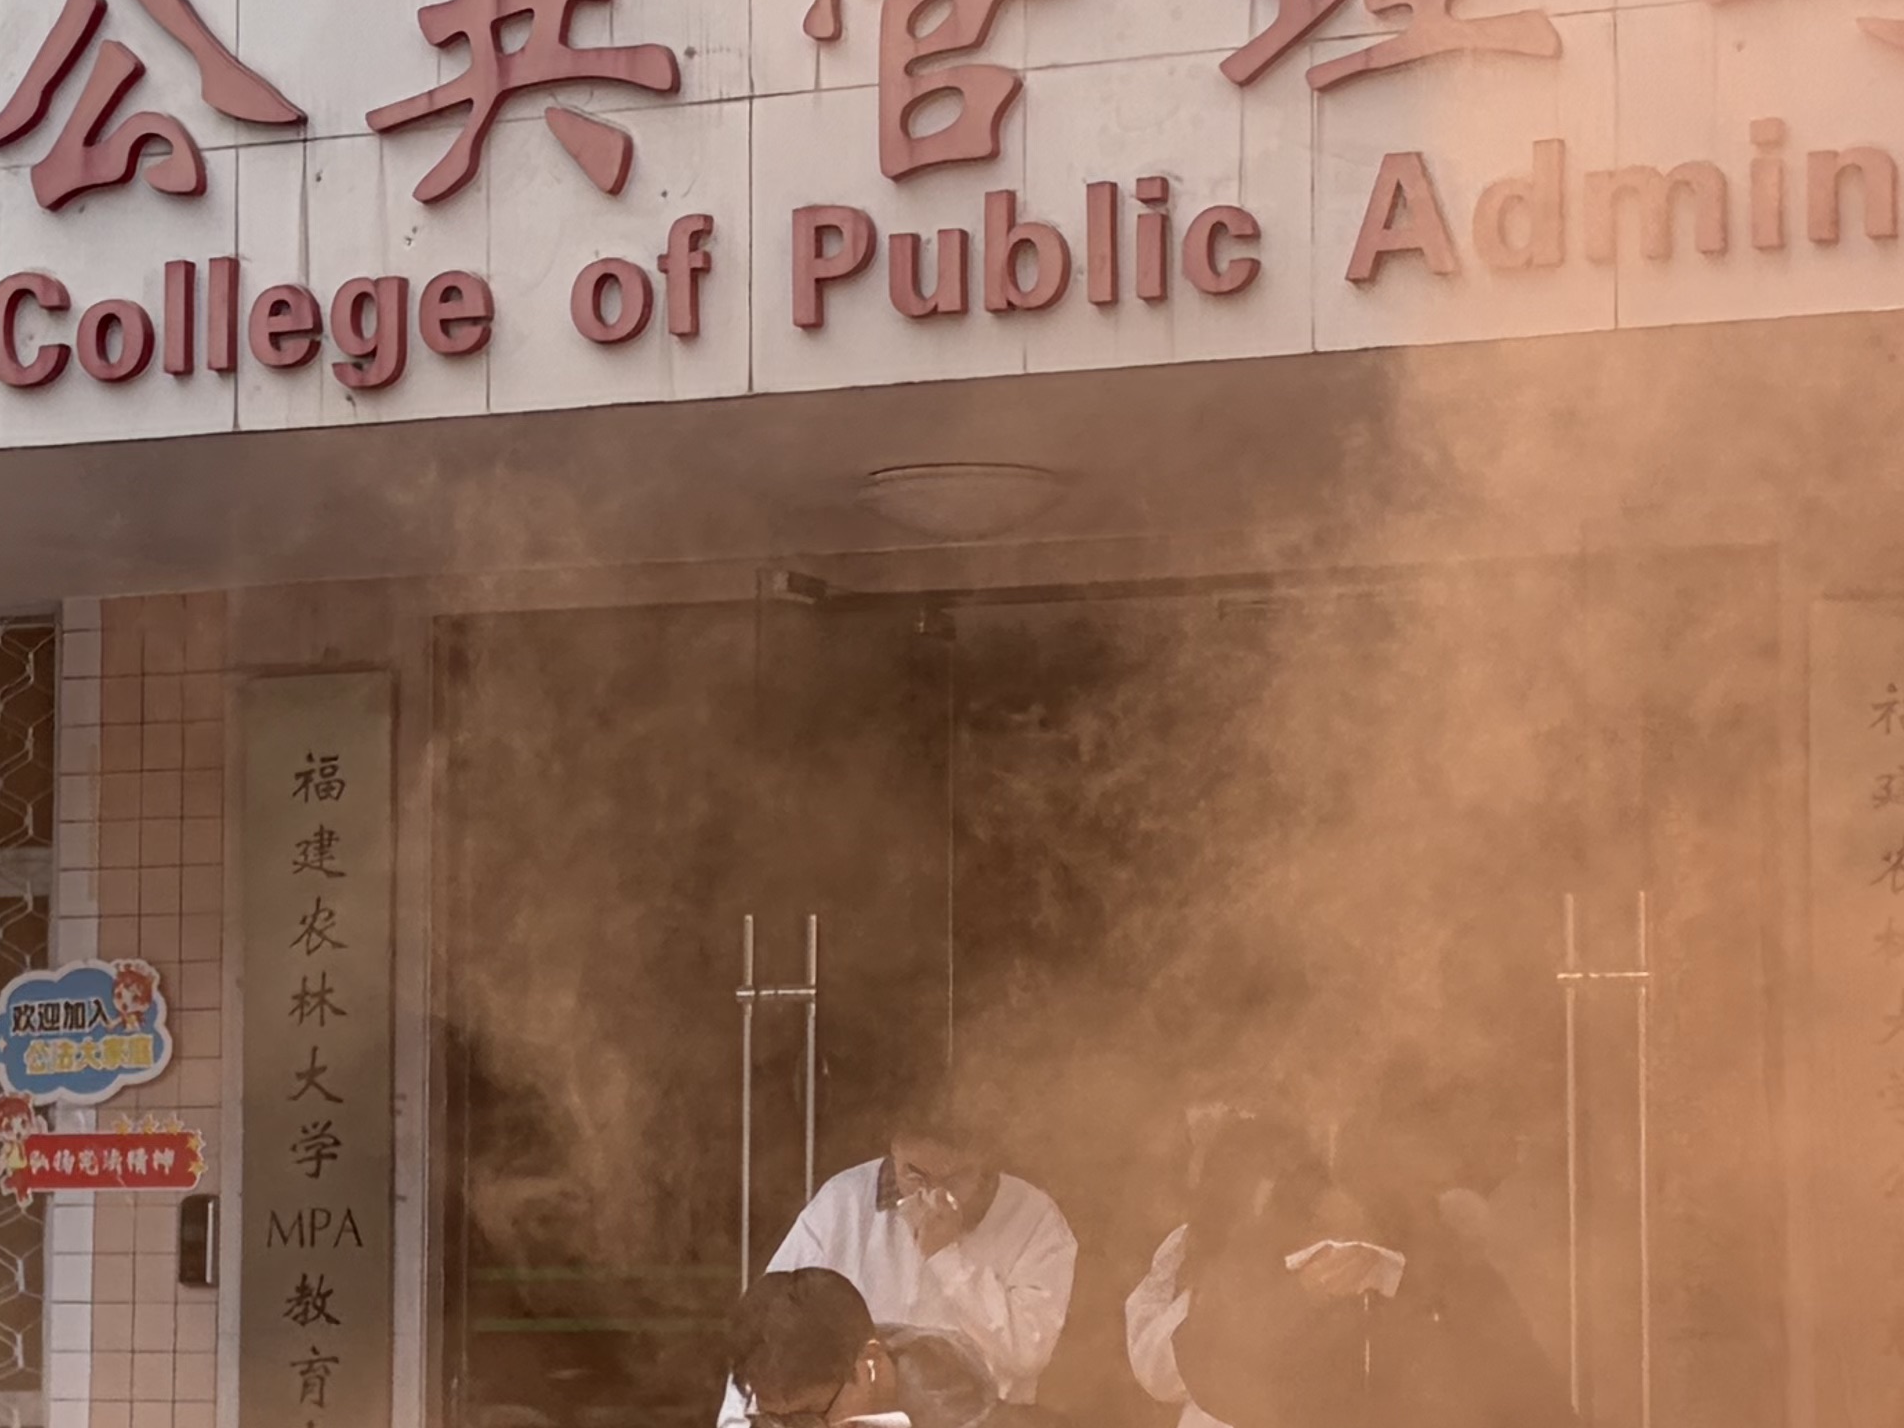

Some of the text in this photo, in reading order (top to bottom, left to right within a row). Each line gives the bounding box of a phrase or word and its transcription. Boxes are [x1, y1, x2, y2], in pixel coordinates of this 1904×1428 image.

[571, 213, 714, 346] of
[792, 175, 1263, 329] Public
[11, 998, 110, 1033] 欢迎加入
